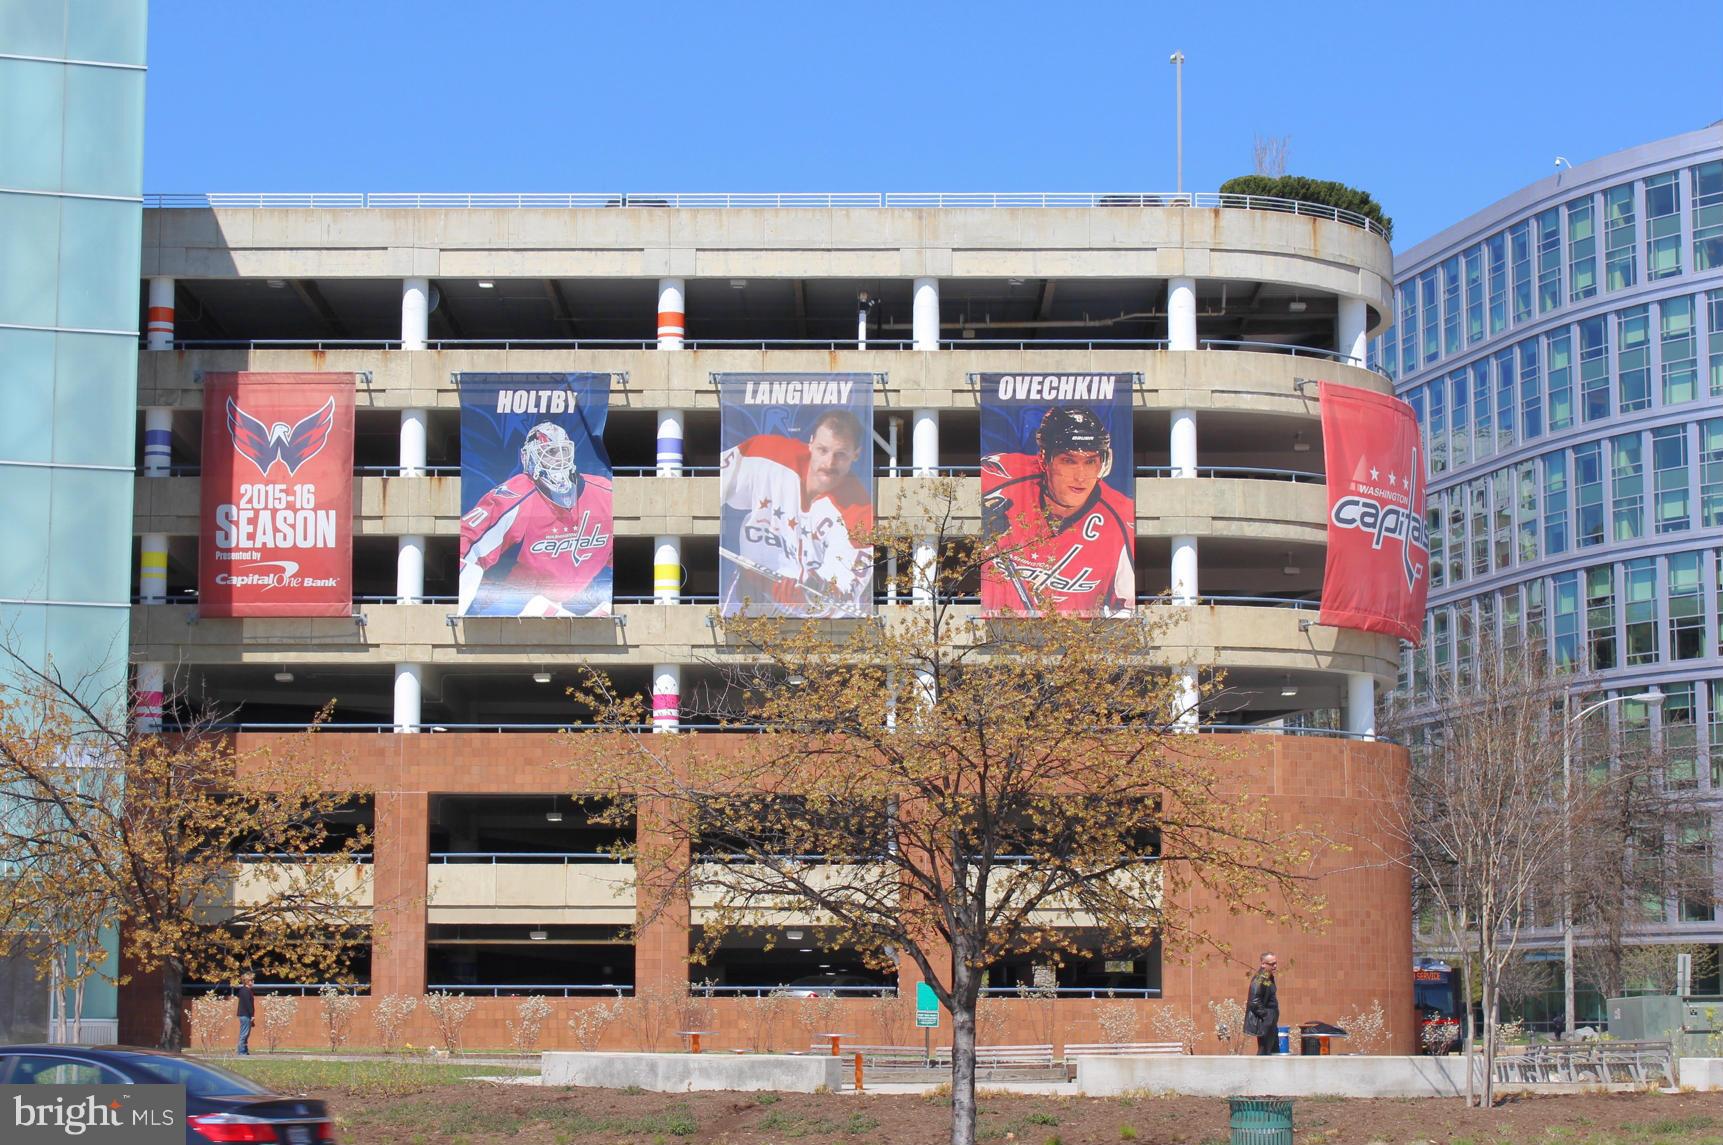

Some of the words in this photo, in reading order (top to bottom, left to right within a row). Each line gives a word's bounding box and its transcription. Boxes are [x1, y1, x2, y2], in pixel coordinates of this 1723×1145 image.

[744, 381, 853, 405] LANGWAY
[998, 375, 1116, 400] OVECHKIN
[496, 389, 577, 414] HOLTBY
[239, 484, 316, 509] 2015-16
[1359, 484, 1408, 505] WASHINGTON
[215, 503, 337, 549] SEASON
[816, 517, 834, 539] C
[1082, 512, 1105, 542] C
[215, 550, 251, 560] Presented
[252, 550, 262, 561] by
[303, 577, 337, 588] Bank
